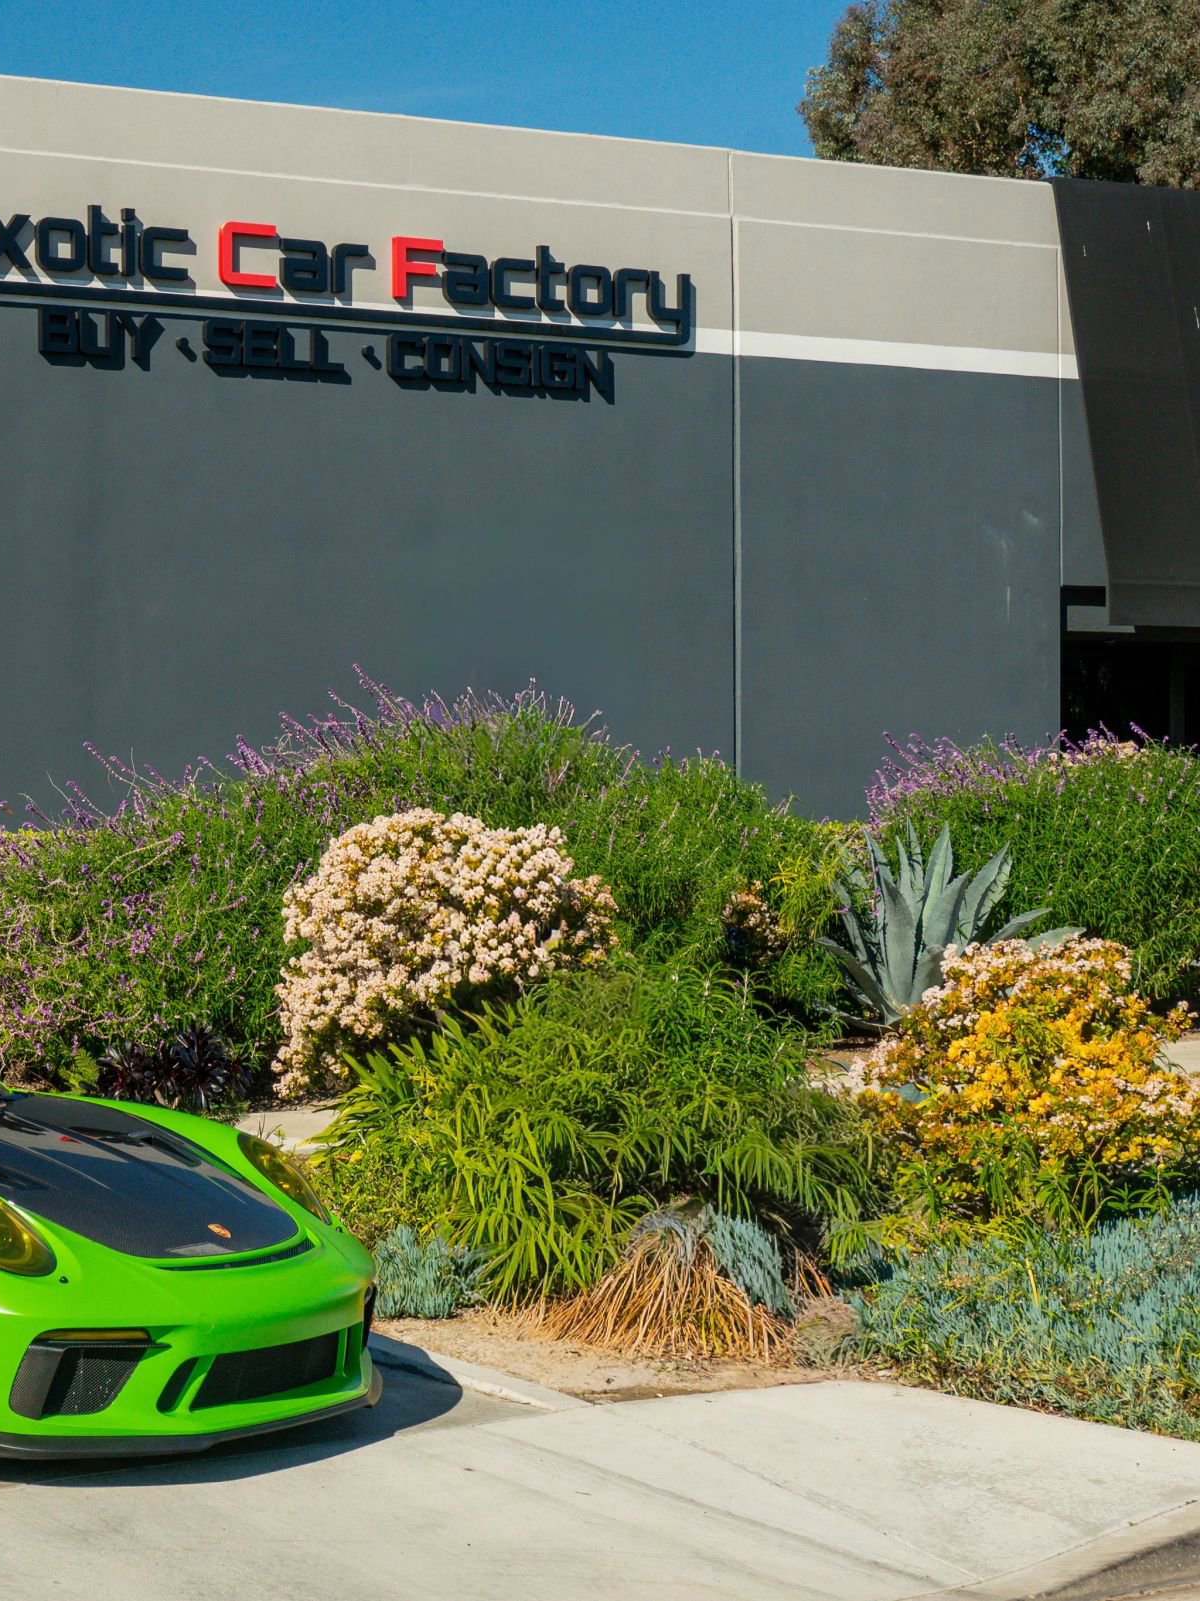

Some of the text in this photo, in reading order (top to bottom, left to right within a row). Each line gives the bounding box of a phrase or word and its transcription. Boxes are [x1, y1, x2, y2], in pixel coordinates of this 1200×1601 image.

[218, 221, 369, 293] Car
[392, 236, 691, 345] Factory
[38, 306, 609, 394] BUY SELL CONSIGN
